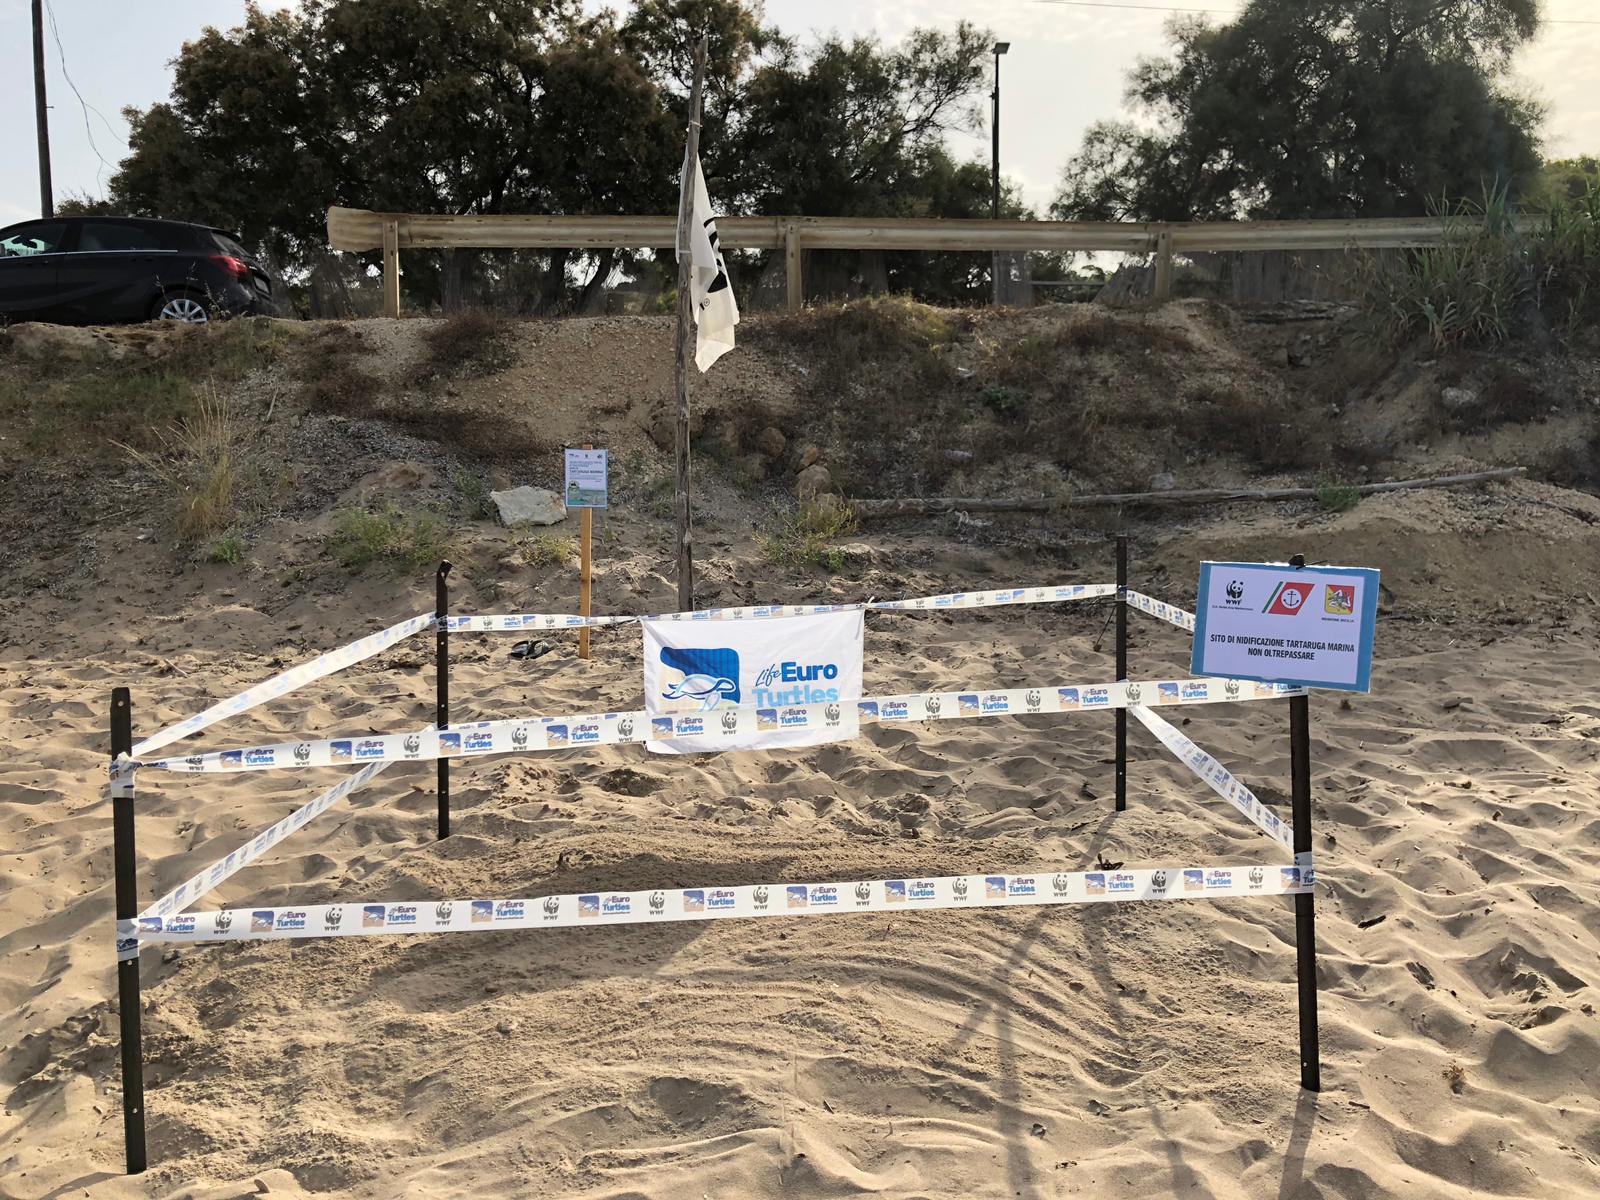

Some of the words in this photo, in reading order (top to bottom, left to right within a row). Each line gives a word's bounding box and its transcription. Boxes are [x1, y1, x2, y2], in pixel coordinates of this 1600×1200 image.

[1210, 633, 1226, 643] SITO
[1227, 635, 1235, 644] DI
[1236, 635, 1285, 648] NIDIFICAZIONE
[1286, 639, 1326, 651] TARTARUGA
[1327, 642, 1355, 653] MARINA
[1247, 647, 1263, 657] NON
[1264, 648, 1315, 661] OLTREPASSARE
[755, 663, 781, 687] Life
[781, 661, 838, 683] Euro
[1189, 682, 1208, 690] Euro
[752, 684, 839, 709] Turtles
[990, 694, 1008, 702] Euro
[788, 708, 807, 716] Euro
[580, 724, 599, 732] Euro
[474, 732, 493, 740] Euro
[253, 748, 275, 756] Euro
[1214, 870, 1232, 878] Euro
[916, 881, 935, 889] Euro
[1017, 877, 1035, 885] Euro
[716, 890, 735, 898] Euro
[818, 886, 837, 894] Euro
[611, 895, 630, 903] Euro
[397, 905, 417, 913] Euro
[286, 911, 307, 919] Euro
